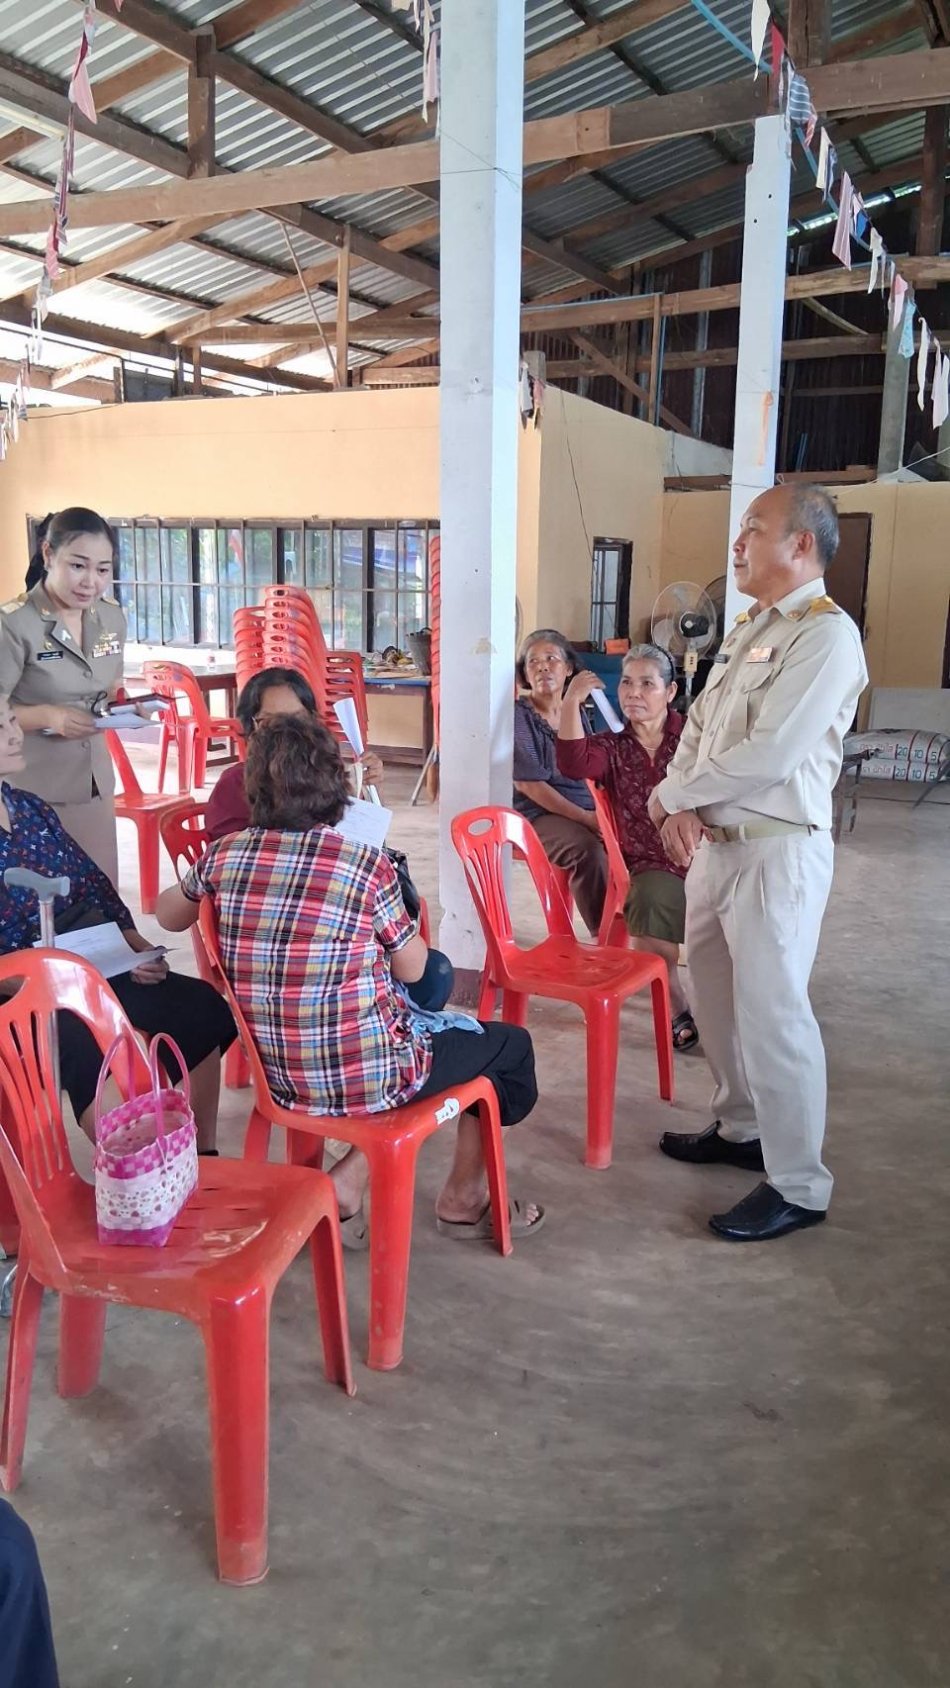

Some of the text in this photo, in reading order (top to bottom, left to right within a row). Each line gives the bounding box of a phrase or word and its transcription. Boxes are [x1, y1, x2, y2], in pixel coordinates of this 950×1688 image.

[898, 747, 908, 756] 20
[914, 750, 923, 758] 10
[931, 752, 937, 761] 5
[896, 768, 906, 777] 20
[912, 769, 922, 779] 10
[929, 771, 936, 780] 5
